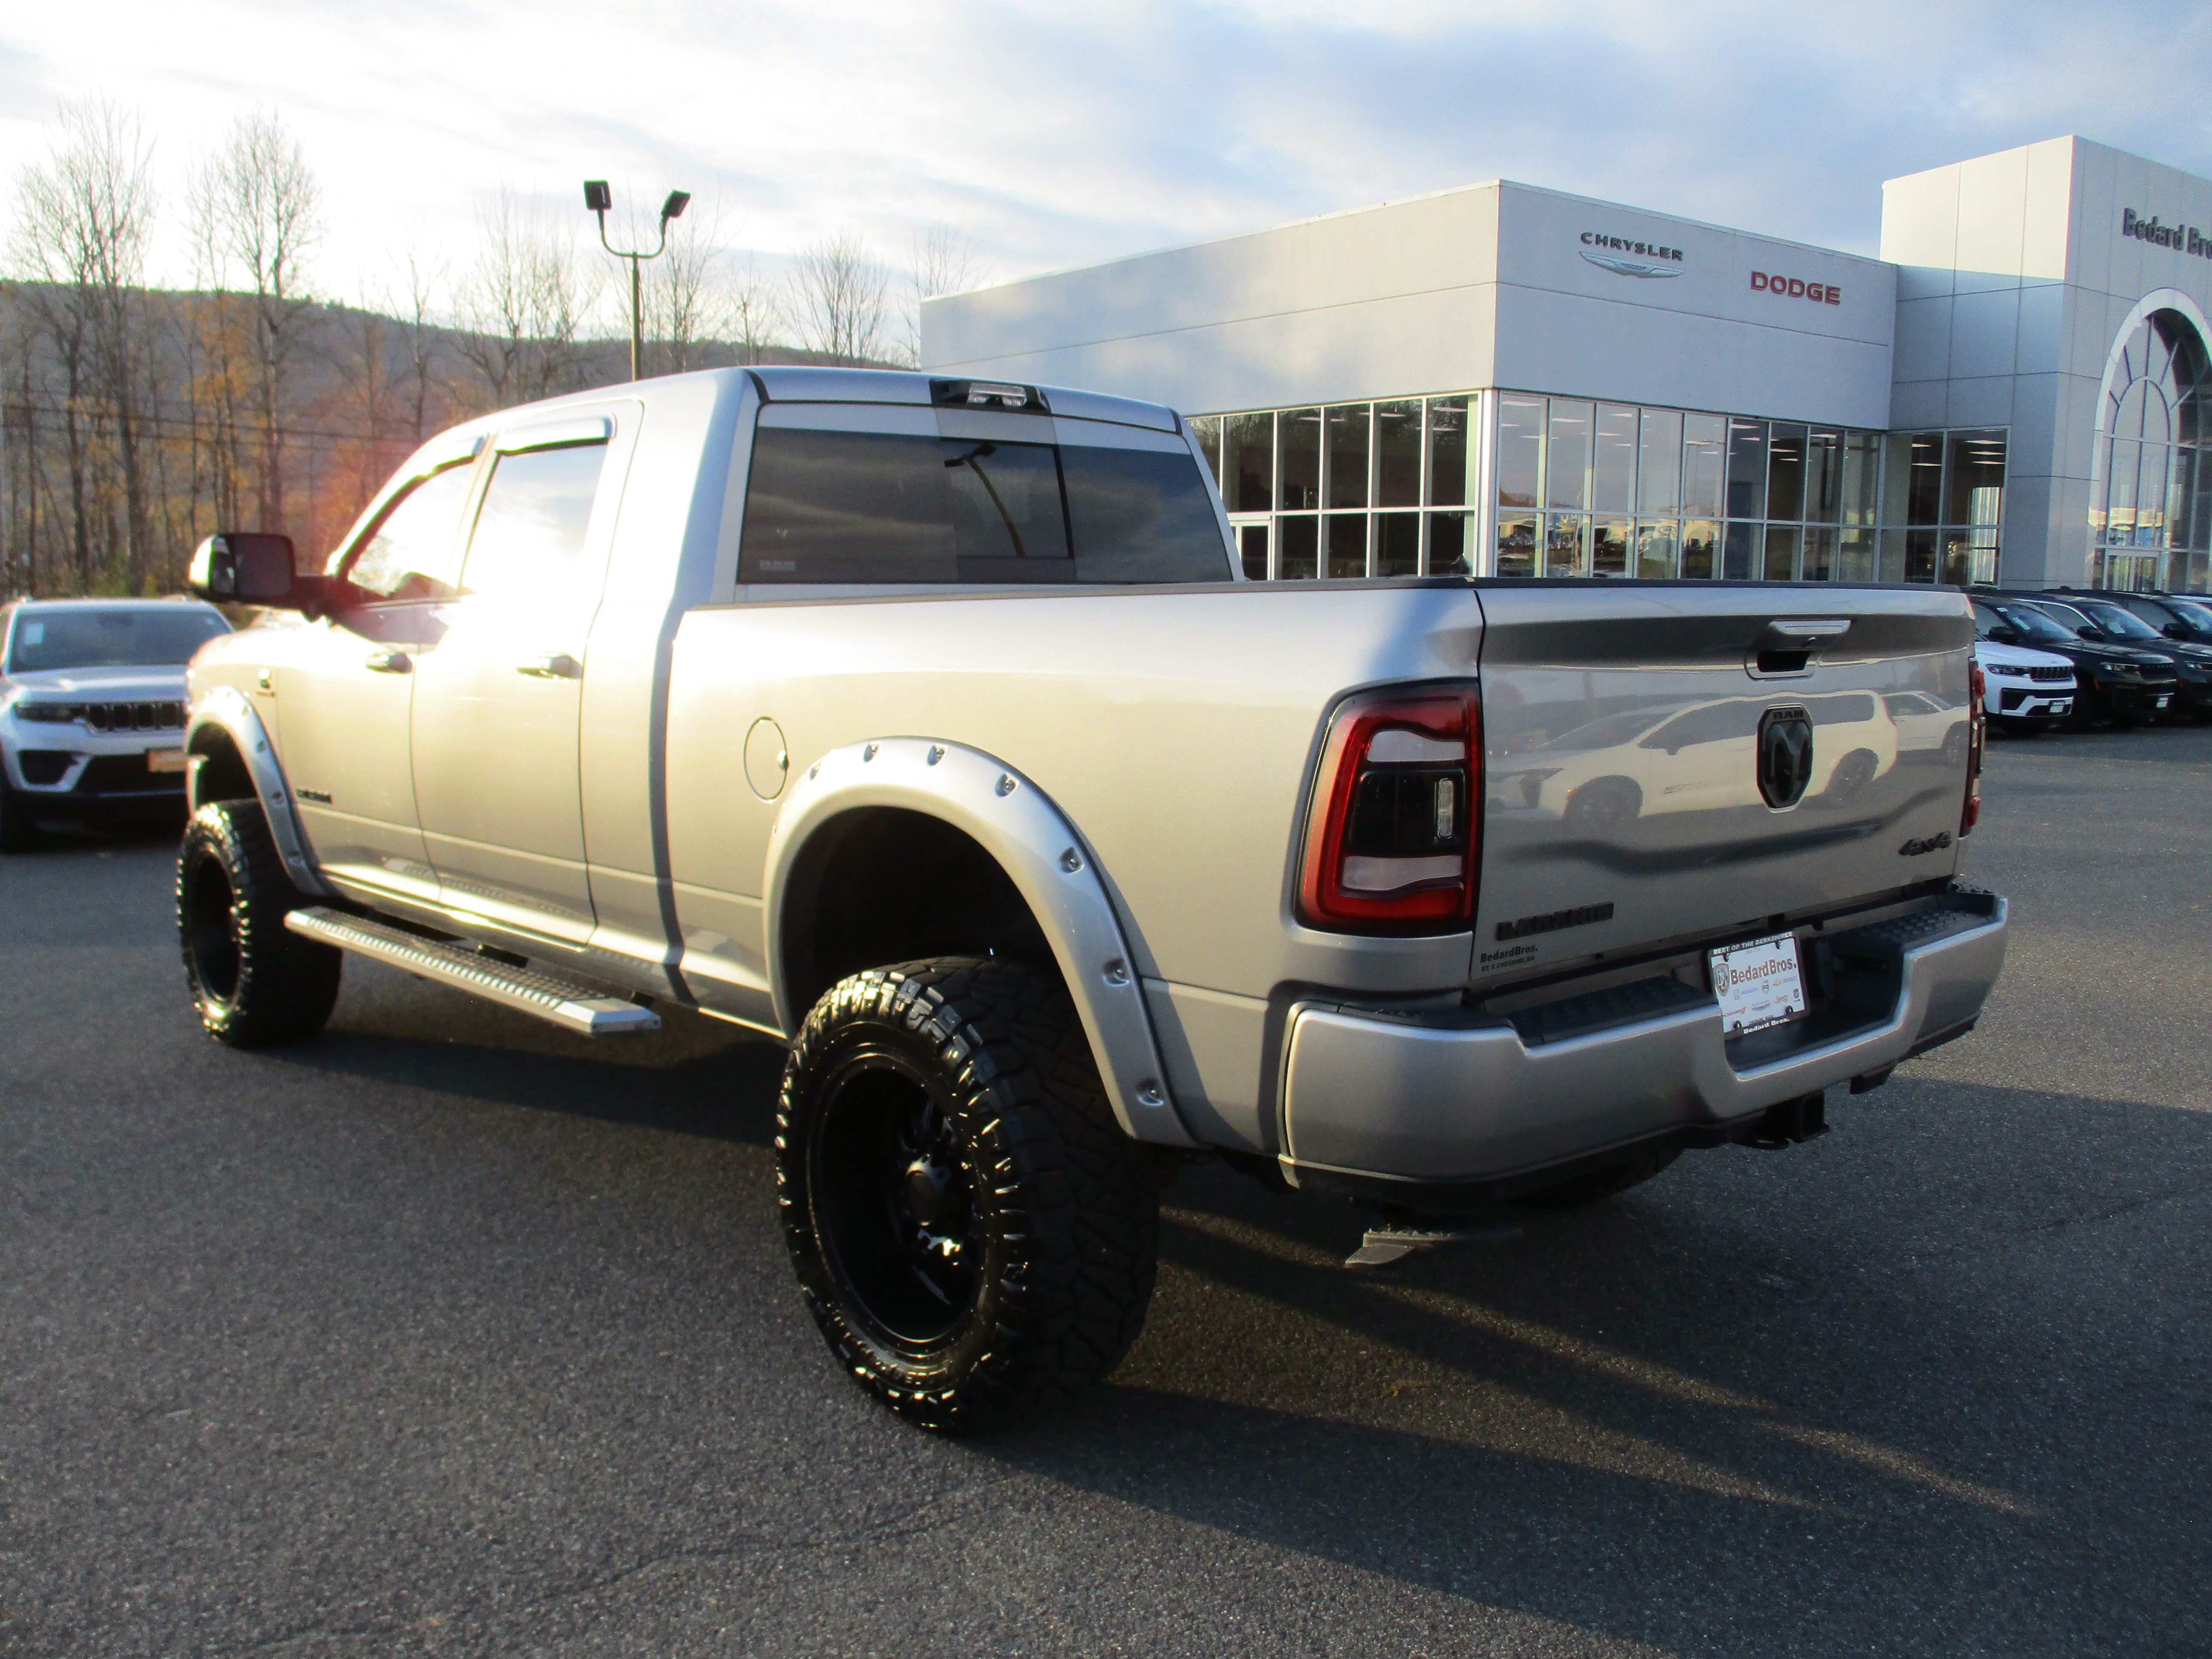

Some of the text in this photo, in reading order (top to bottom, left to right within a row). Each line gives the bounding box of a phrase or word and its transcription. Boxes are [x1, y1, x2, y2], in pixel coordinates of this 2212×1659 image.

[2122, 207, 2185, 251] Bedard
[1580, 231, 1684, 261] CHRYSLER
[1750, 270, 1841, 305] DODGE
[1773, 710, 1804, 720] RAM
[1713, 946, 1730, 955] BEST
[1741, 940, 1754, 948] THE
[1755, 931, 1793, 945] BERKSHIRES
[1743, 1022, 1770, 1034] Bedard
[1771, 1017, 1791, 1026] Bros.
